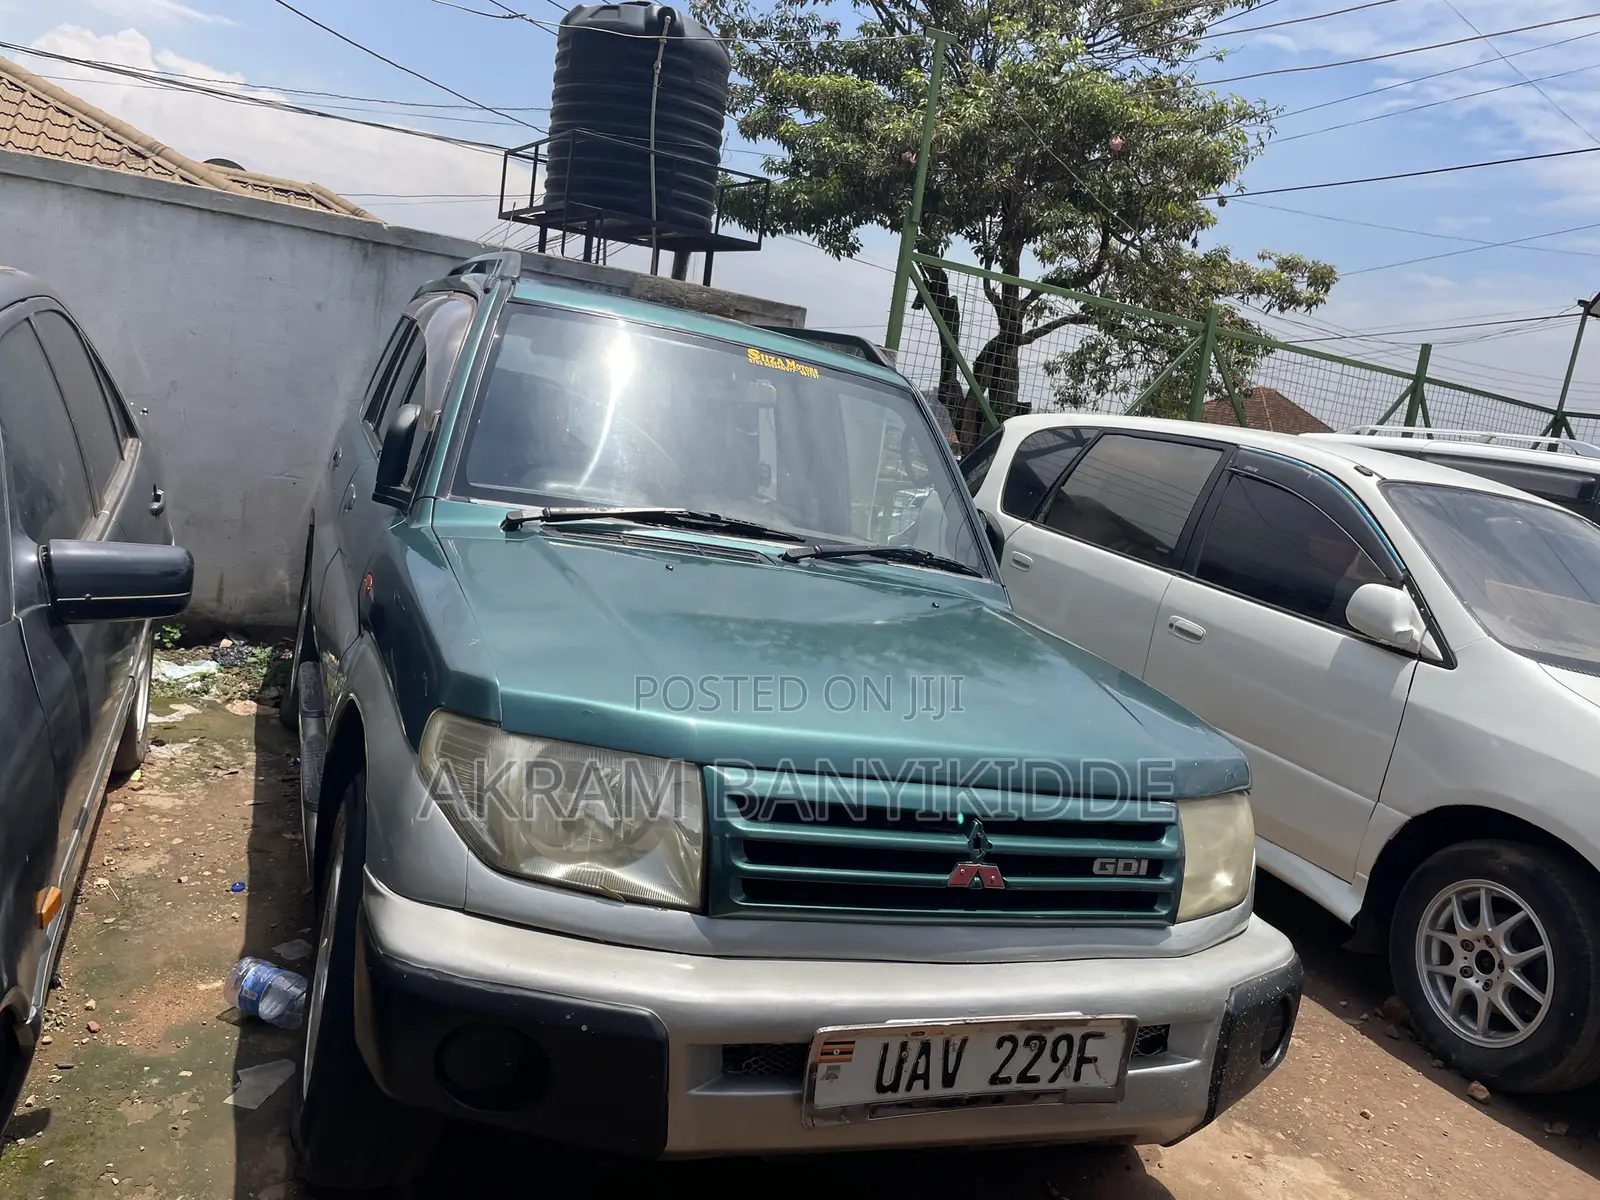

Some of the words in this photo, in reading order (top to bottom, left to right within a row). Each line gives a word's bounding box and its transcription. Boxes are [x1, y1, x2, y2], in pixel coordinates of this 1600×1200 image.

[1093, 858, 1149, 876] GDI
[875, 1035, 969, 1094] UAV
[988, 1031, 1105, 1086] 229F
